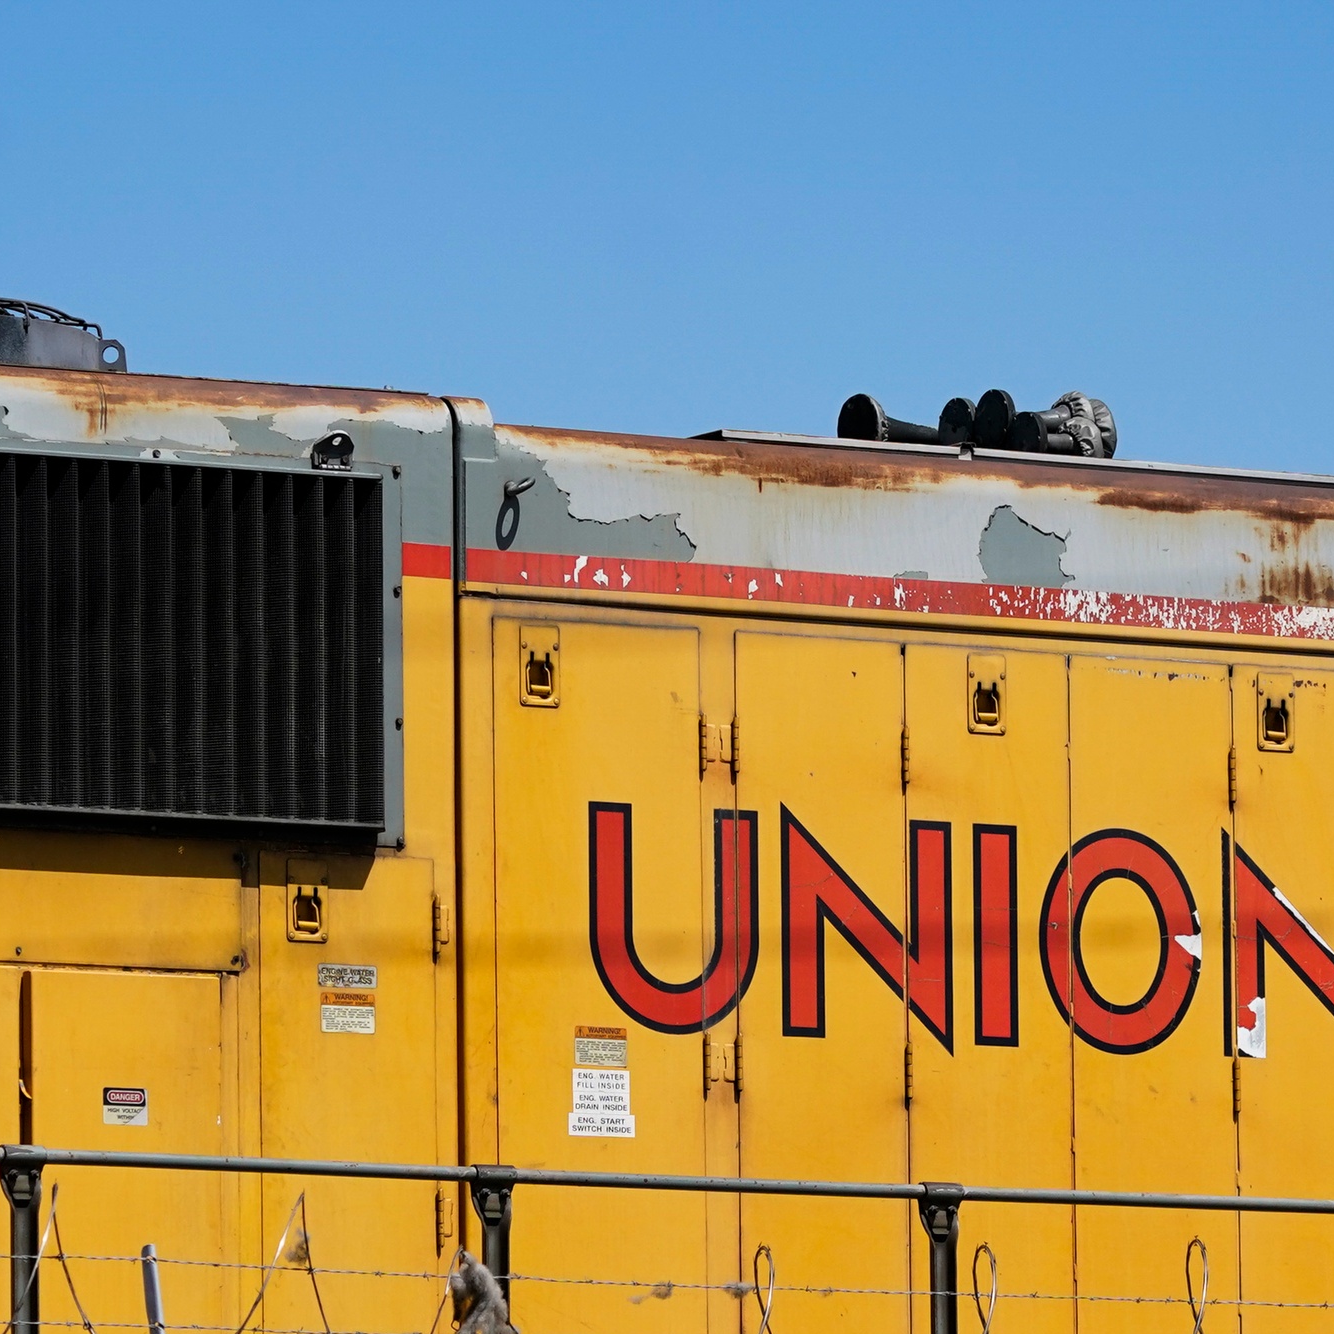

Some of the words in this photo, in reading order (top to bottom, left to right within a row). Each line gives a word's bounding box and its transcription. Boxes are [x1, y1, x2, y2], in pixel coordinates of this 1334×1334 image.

[334, 993, 368, 1001] WARNING!
[587, 1027, 621, 1035] WARNING!
[599, 1073, 625, 1081] WATER
[598, 1082, 626, 1090] INSIDE
[110, 1093, 141, 1101] DANGER
[600, 1117, 625, 1125] START
[572, 1124, 602, 1132] SWITCH
[605, 1126, 632, 1134] INSIDE
